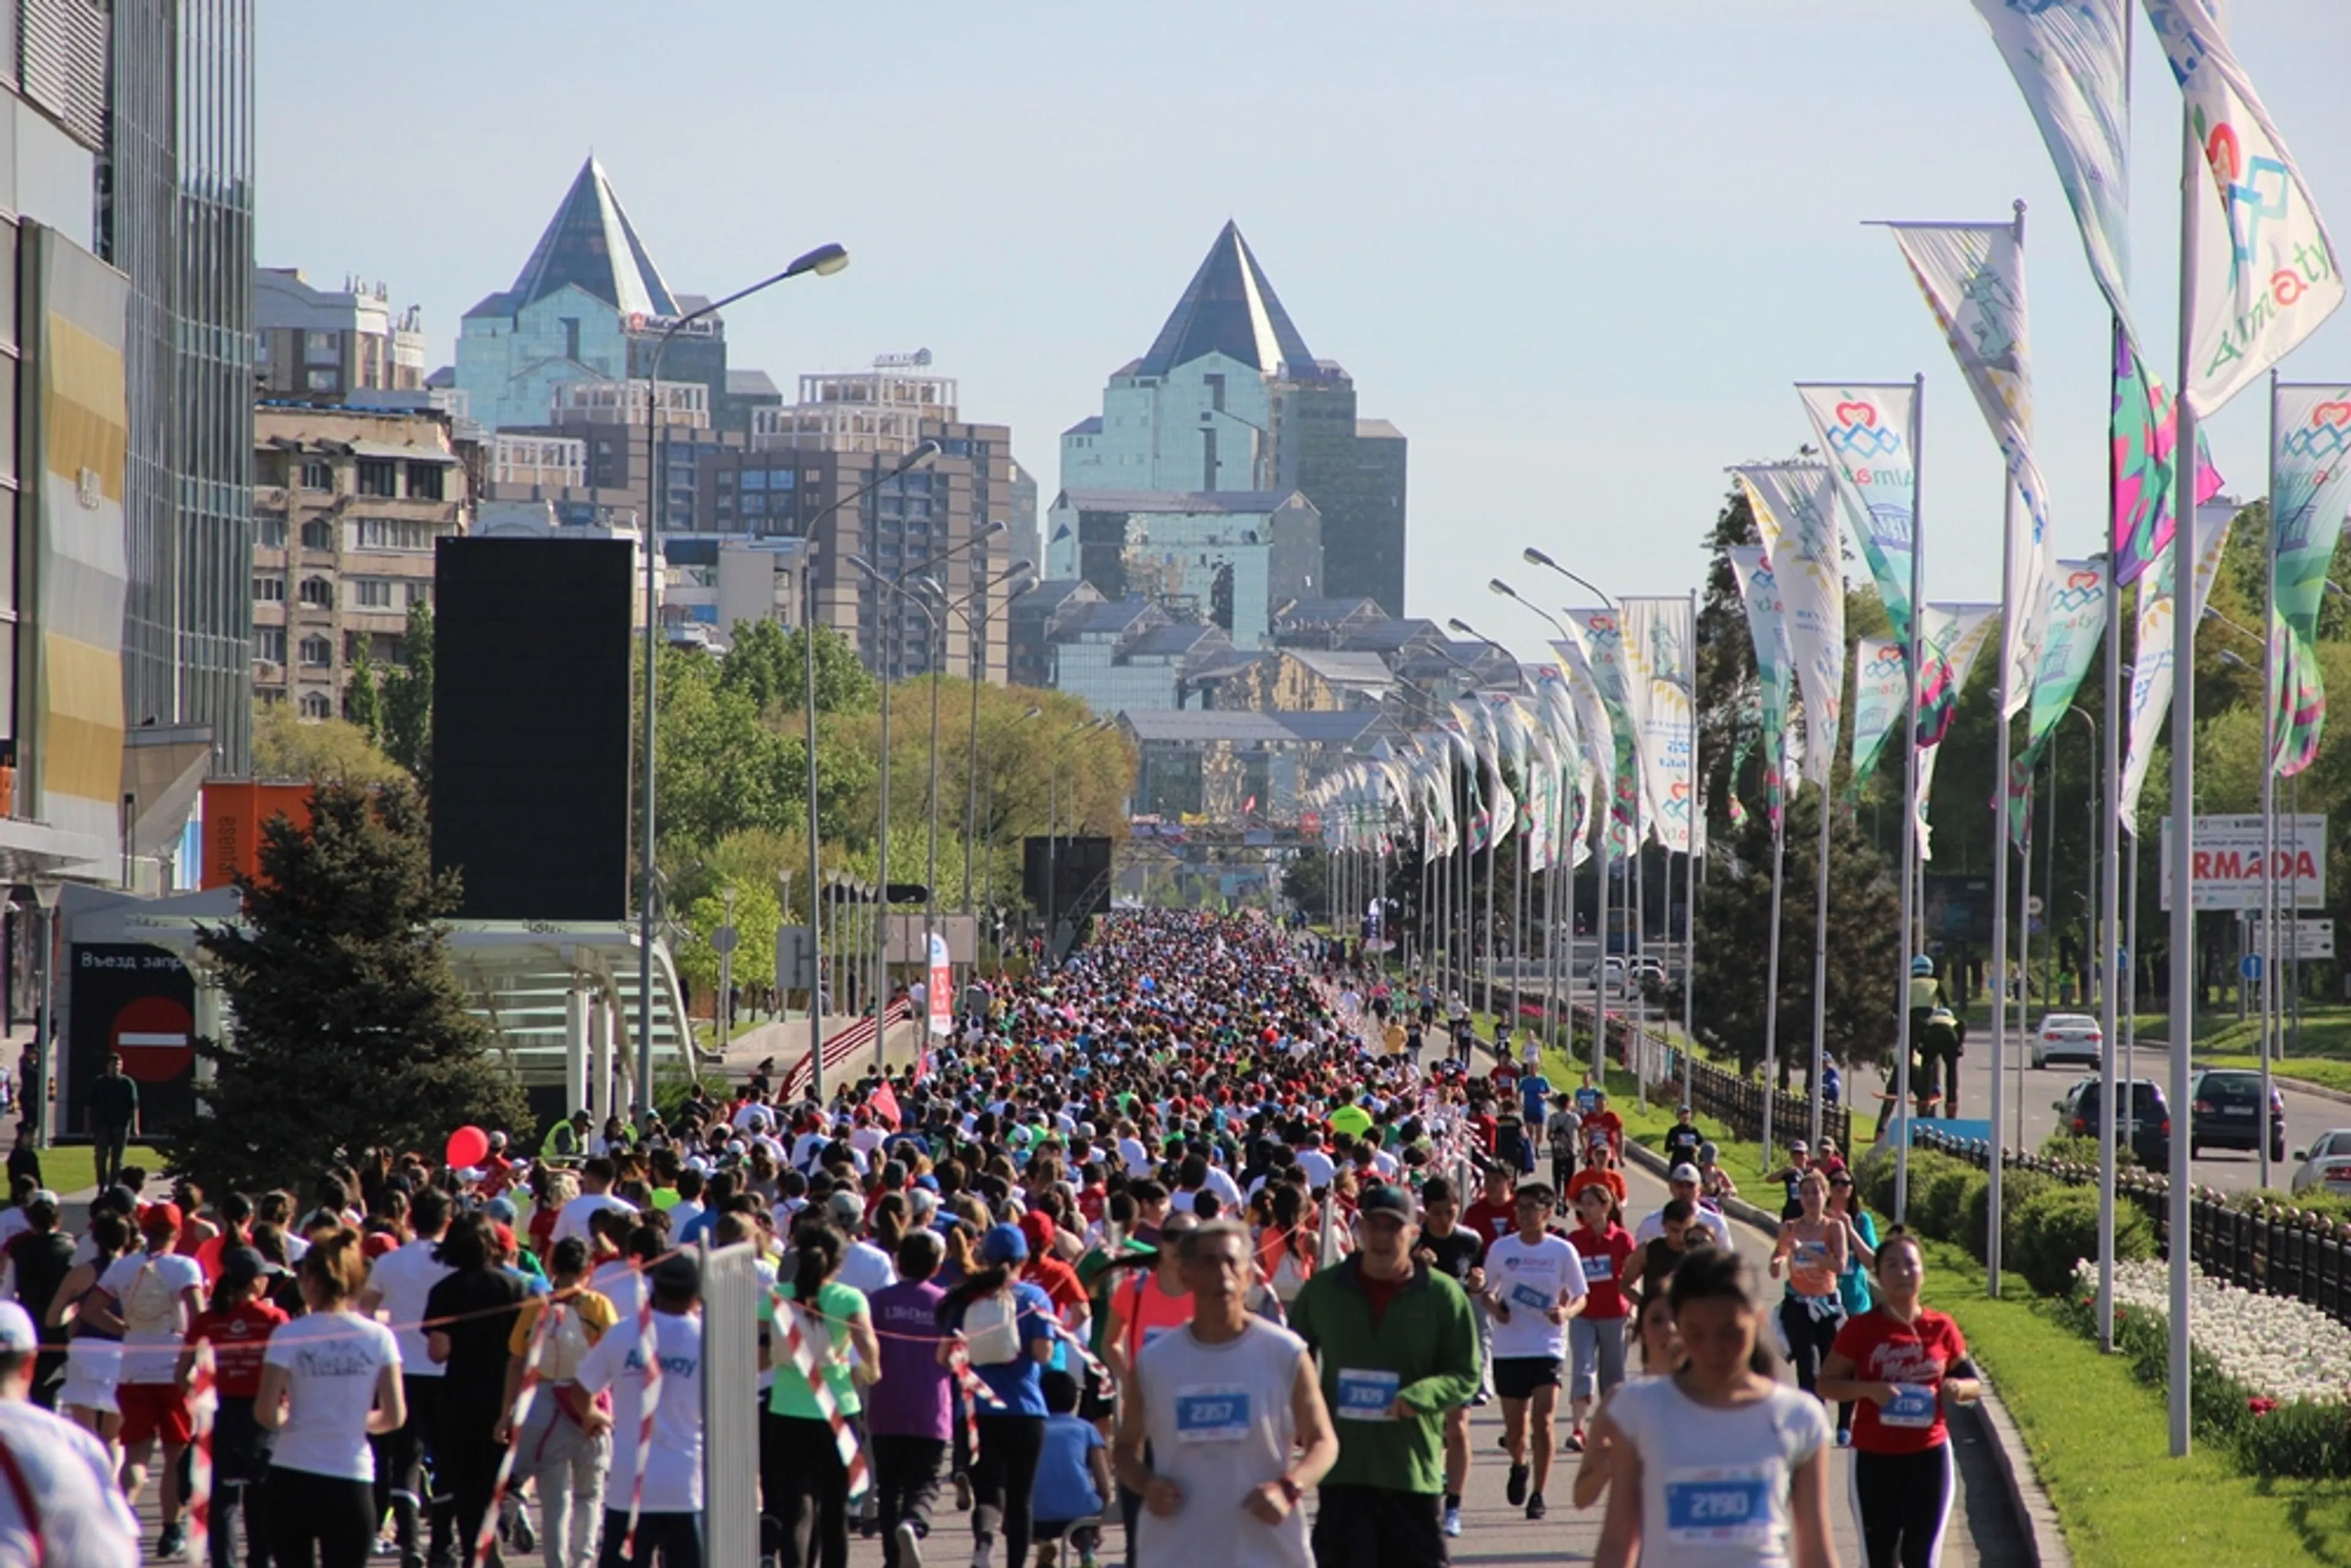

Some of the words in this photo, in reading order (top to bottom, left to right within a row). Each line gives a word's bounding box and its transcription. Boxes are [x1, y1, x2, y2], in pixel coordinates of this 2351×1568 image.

[2205, 230, 2330, 378] Almaty
[2168, 850, 2317, 880] RMADA
[81, 951, 137, 970] Въезд
[142, 956, 183, 972] запр
[624, 1349, 697, 1379] Away
